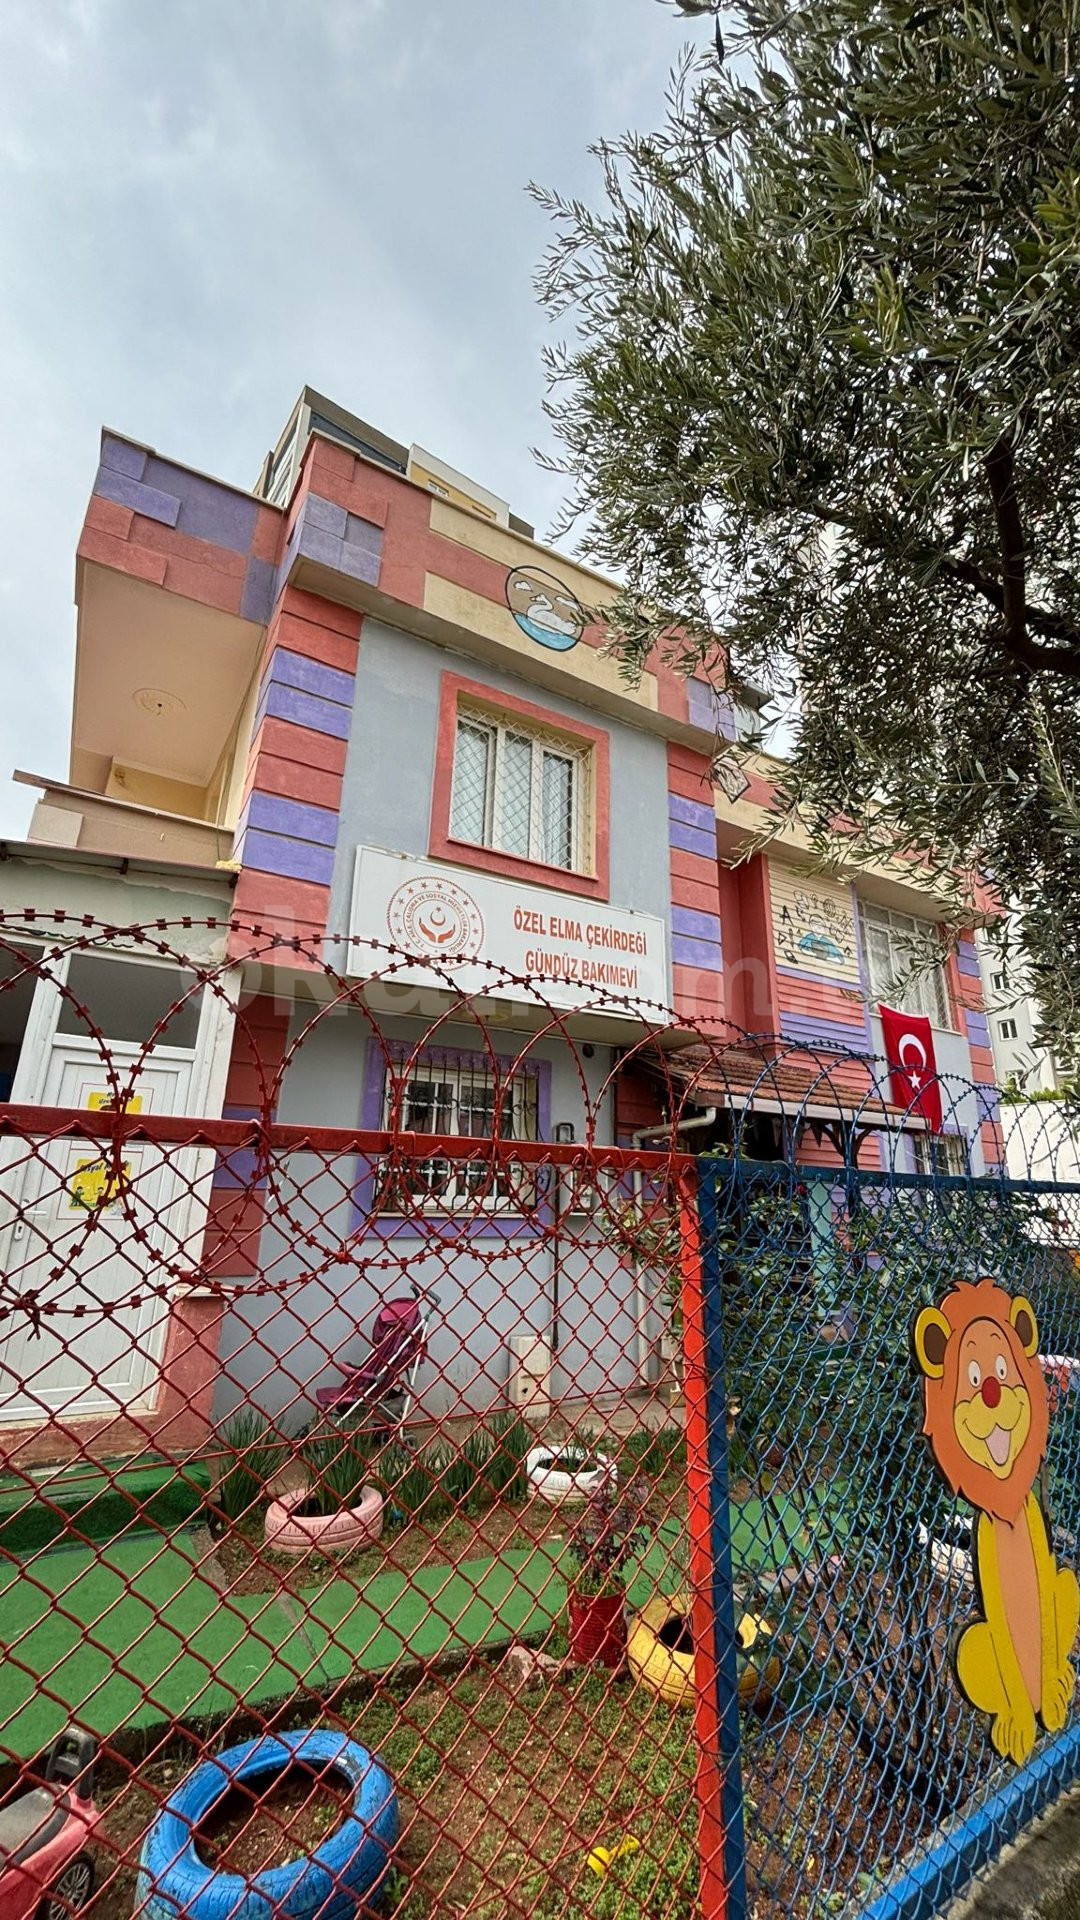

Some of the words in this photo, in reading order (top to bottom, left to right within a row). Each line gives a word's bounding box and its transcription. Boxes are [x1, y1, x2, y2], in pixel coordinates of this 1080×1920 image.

[513, 904, 547, 936] ÖZEL
[549, 916, 583, 942] ELMA
[586, 923, 647, 956] ÇEKİRDEĞİ
[525, 947, 579, 978] GÜNDÜZ
[581, 964, 638, 989] BAKIMEVİ
